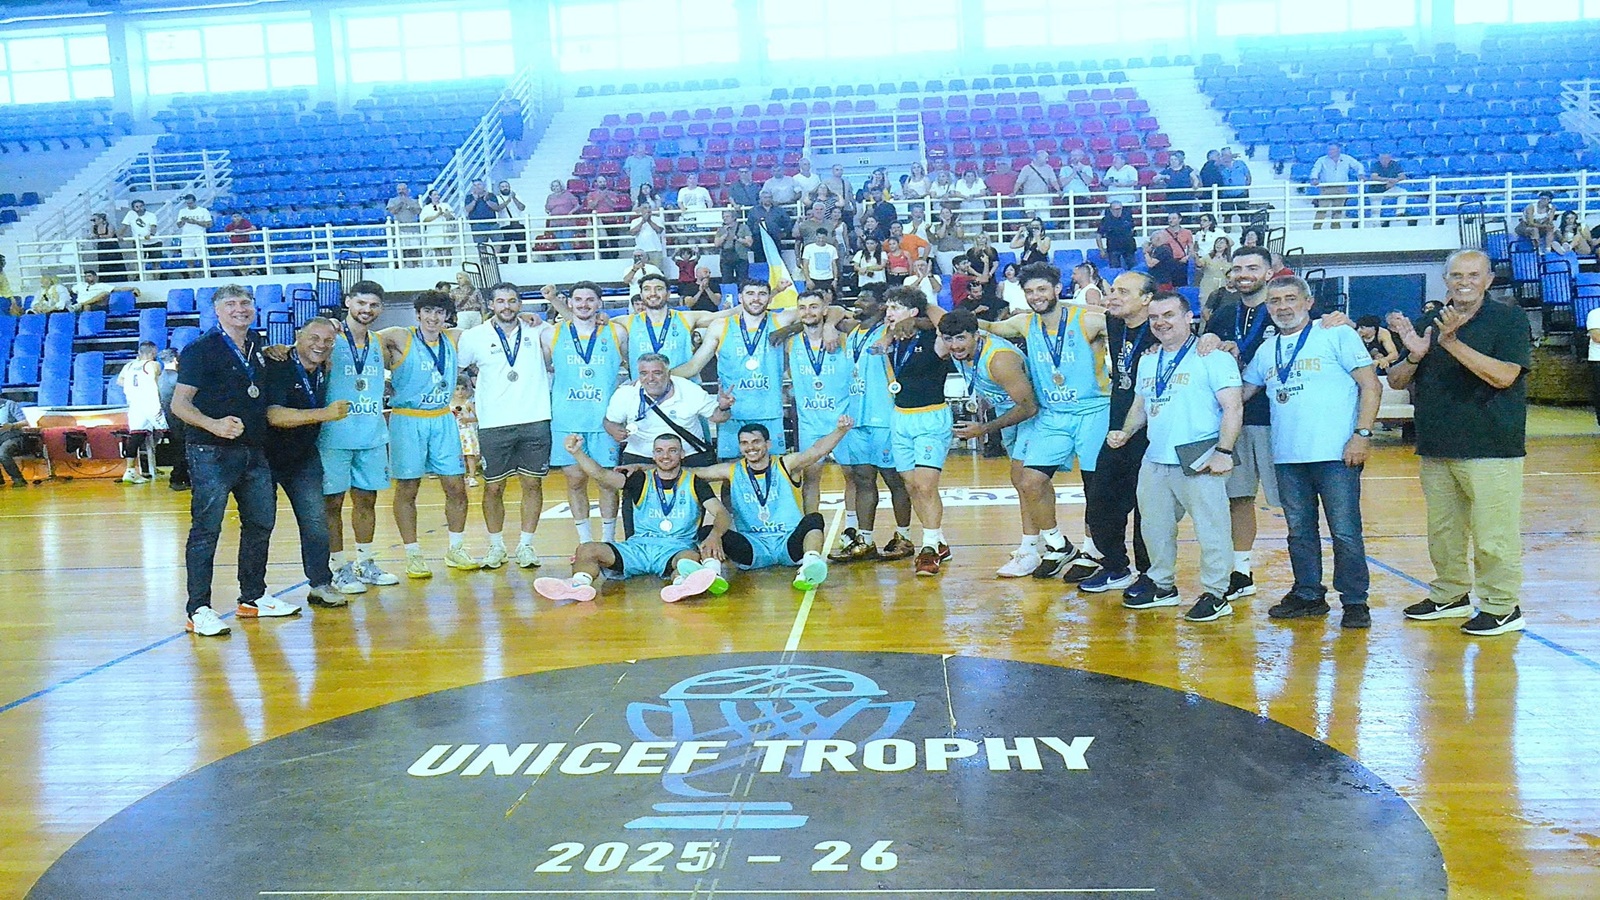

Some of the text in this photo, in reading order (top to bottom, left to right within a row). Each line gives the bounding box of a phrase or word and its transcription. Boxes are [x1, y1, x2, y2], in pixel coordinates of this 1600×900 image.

[406, 737, 1095, 777] UNICEF TROPHY
[533, 842, 720, 873] 2025
[811, 840, 898, 872] 26
